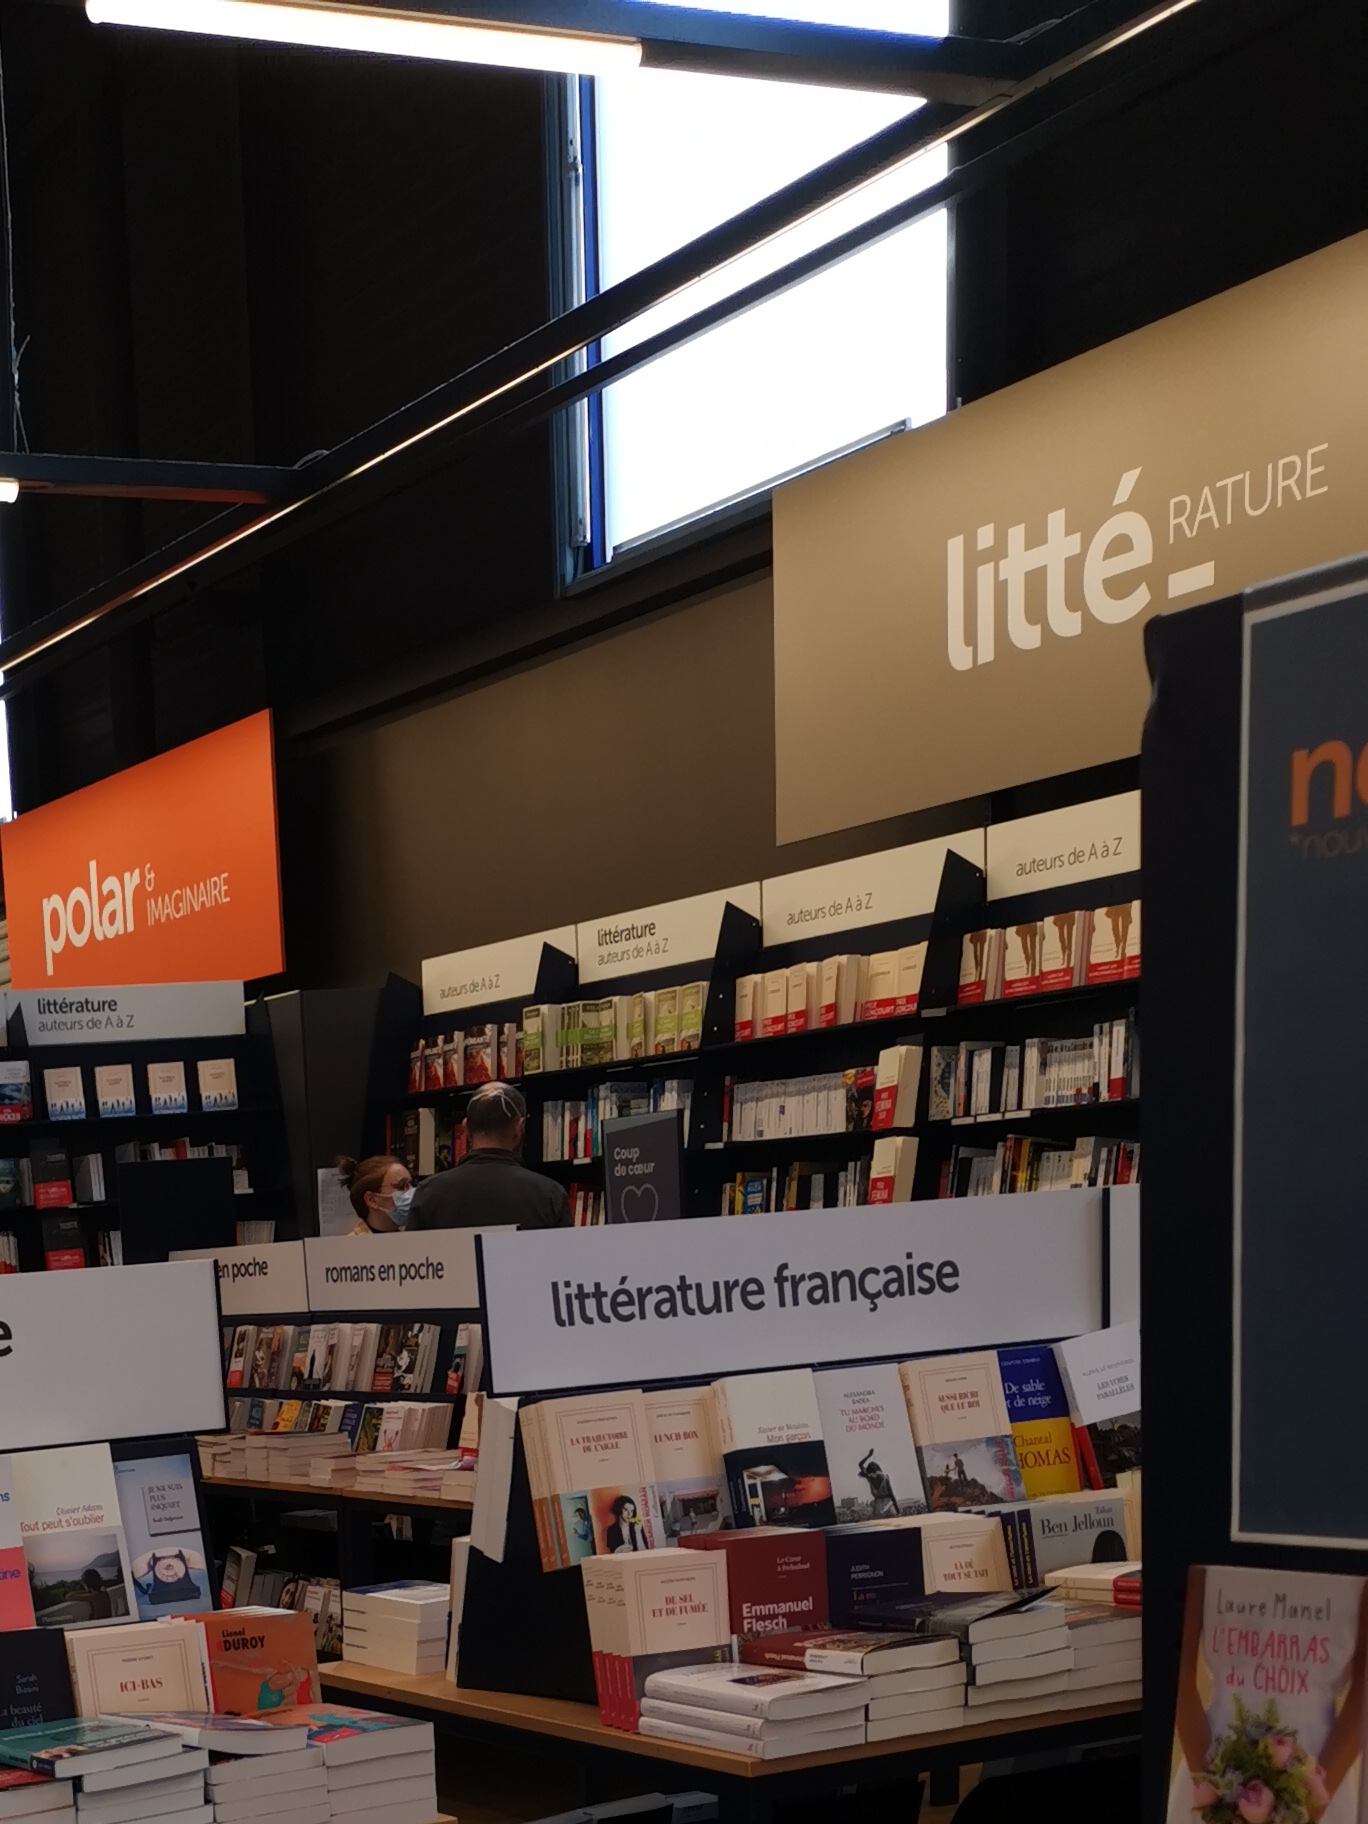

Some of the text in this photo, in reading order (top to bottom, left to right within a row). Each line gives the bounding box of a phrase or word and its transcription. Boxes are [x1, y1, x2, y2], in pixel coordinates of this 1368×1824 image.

[1168, 443, 1329, 544] RATURE
[1016, 853, 1065, 877] auteurs
[1067, 847, 1086, 866] de
[1087, 843, 1099, 861] A
[1112, 837, 1123, 856] Z
[147, 872, 230, 926] IMAGINAIRE
[786, 901, 827, 926] auteurs
[828, 898, 843, 917] de
[845, 897, 854, 913] A
[864, 893, 873, 910] Z
[42, 859, 155, 976] polar &
[597, 921, 656, 947] littérature
[598, 946, 630, 966] auteurs
[632, 944, 643, 959] de
[645, 942, 653, 955] A
[662, 938, 669, 953] Z
[37, 997, 117, 1014] littérature
[38, 1019, 84, 1032] auteurs
[86, 1017, 102, 1029] de
[105, 1015, 114, 1028] A
[126, 1014, 135, 1028] Z
[614, 1147, 640, 1162] Coup
[614, 1162, 655, 1176] de cœur
[232, 1256, 269, 1282] poche
[326, 1256, 444, 1286] romans en poche
[551, 1250, 961, 1329] littérature française
[1040, 1512, 1114, 1535] Ben Jelloun
[742, 1596, 813, 1618] Emmanuel
[1217, 1588, 1332, 1622] Laure Manel
[743, 1615, 788, 1632] Flesch
[222, 1635, 266, 1652] DUROY
[1212, 1626, 1330, 1664] L'EMBARRAS
[120, 1677, 163, 1693] ICI-BAS
[1225, 1664, 1310, 1695] du CHOIX
